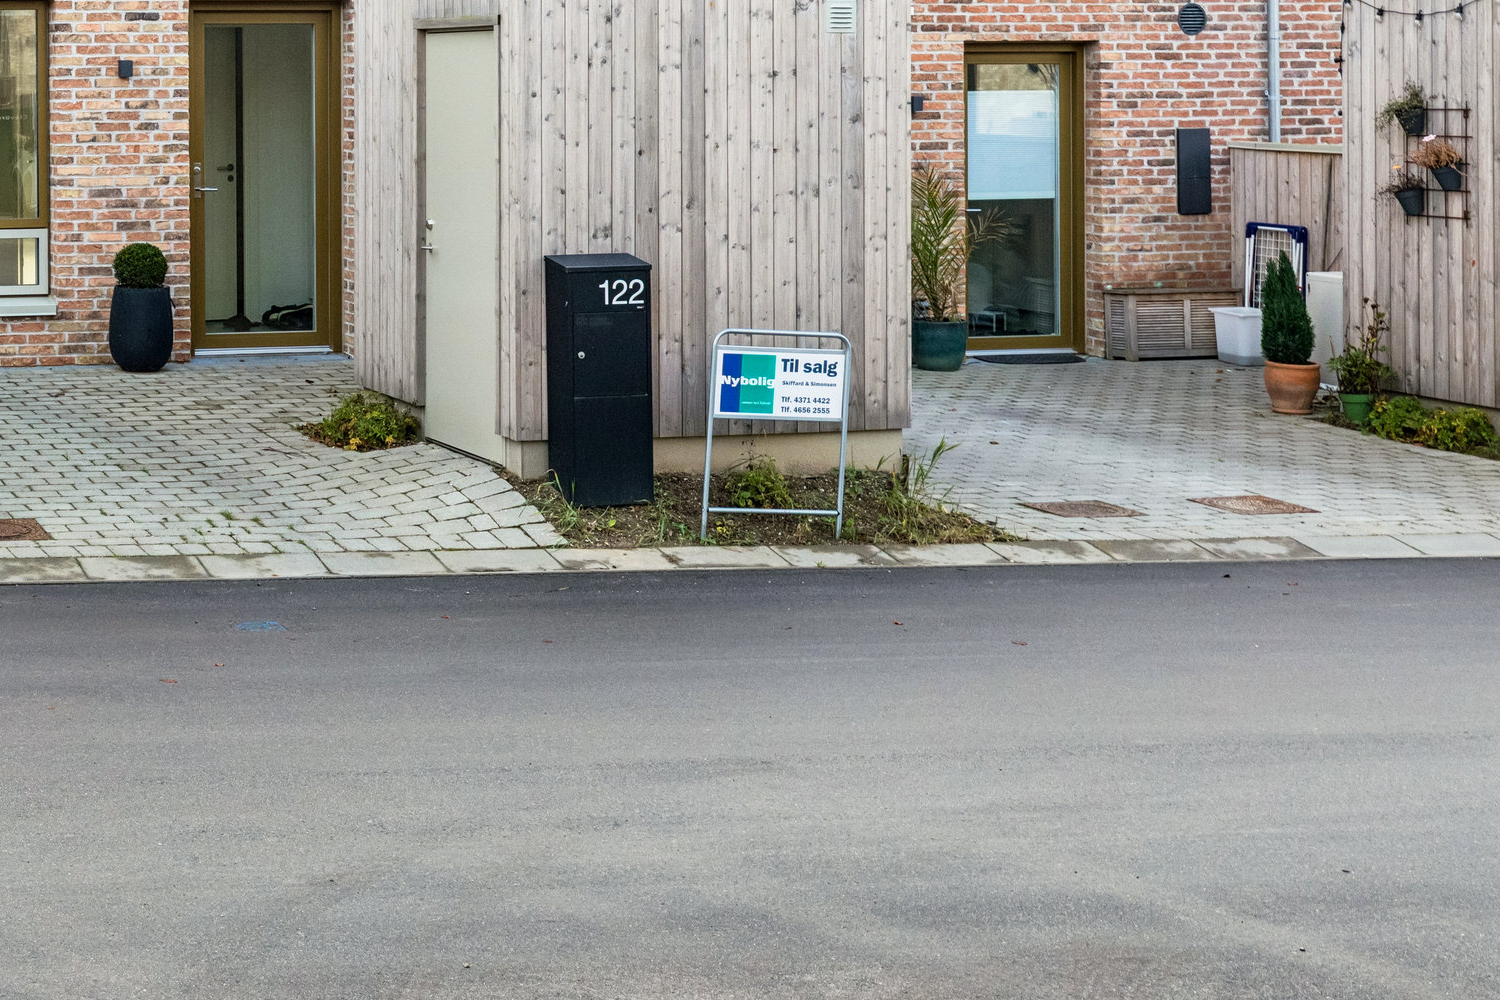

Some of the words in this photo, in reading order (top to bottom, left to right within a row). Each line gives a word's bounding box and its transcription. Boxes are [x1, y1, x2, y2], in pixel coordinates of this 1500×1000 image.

[598, 279, 645, 305] 122
[781, 358, 799, 373] Til
[803, 360, 838, 377] salg
[721, 375, 776, 389] Nybolig
[793, 396, 811, 404] 4371
